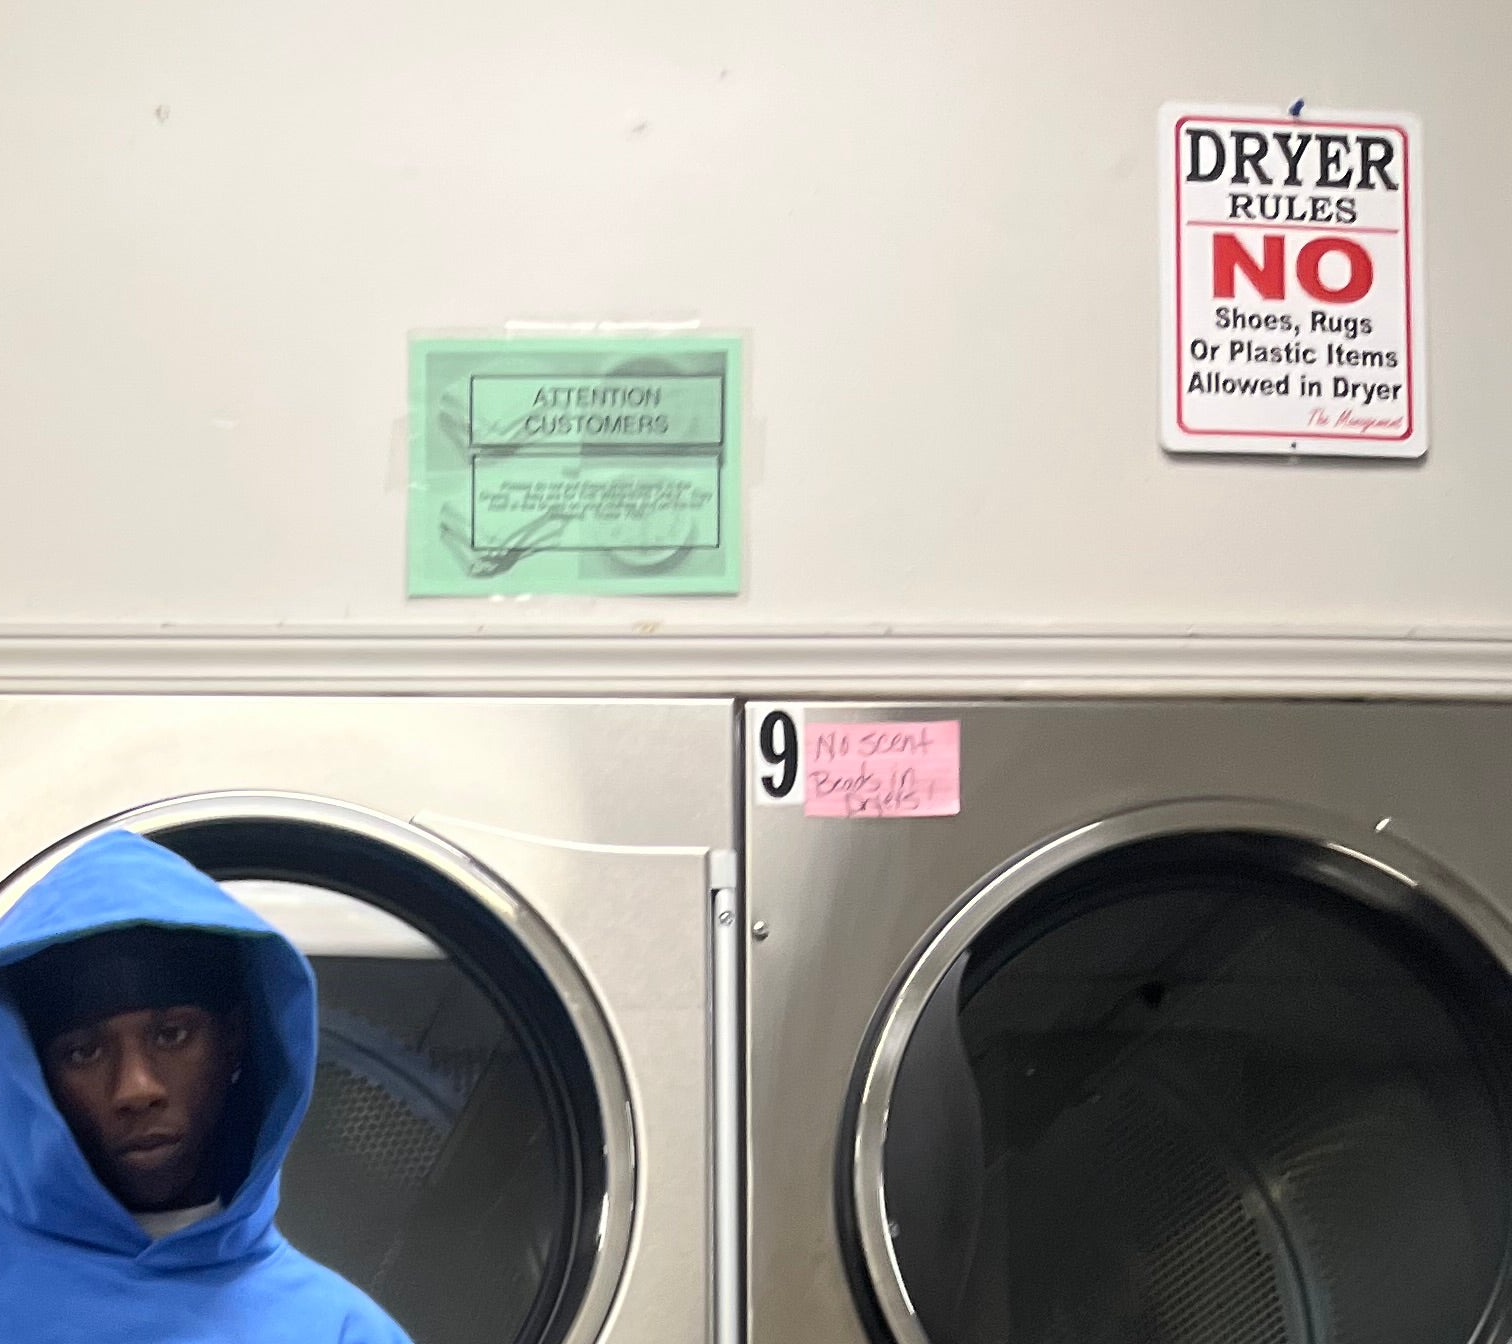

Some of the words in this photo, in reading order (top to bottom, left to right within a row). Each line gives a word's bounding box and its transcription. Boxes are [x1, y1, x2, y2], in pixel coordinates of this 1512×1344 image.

[1186, 128, 1399, 190] DRYER
[1226, 192, 1358, 224] RULES
[1213, 232, 1374, 305] NO
[1215, 306, 1301, 336] Shoes,
[1310, 310, 1372, 340] Rugs
[1190, 338, 1220, 361] Or
[1230, 339, 1318, 365] Plastic
[1327, 343, 1398, 368] Items
[532, 386, 662, 408] ATTENTION
[1187, 371, 1289, 396] Allowed
[1301, 375, 1323, 398] in
[1333, 377, 1403, 404] Dryer
[524, 414, 670, 435] CUSTOMERS
[760, 710, 799, 798] 9
